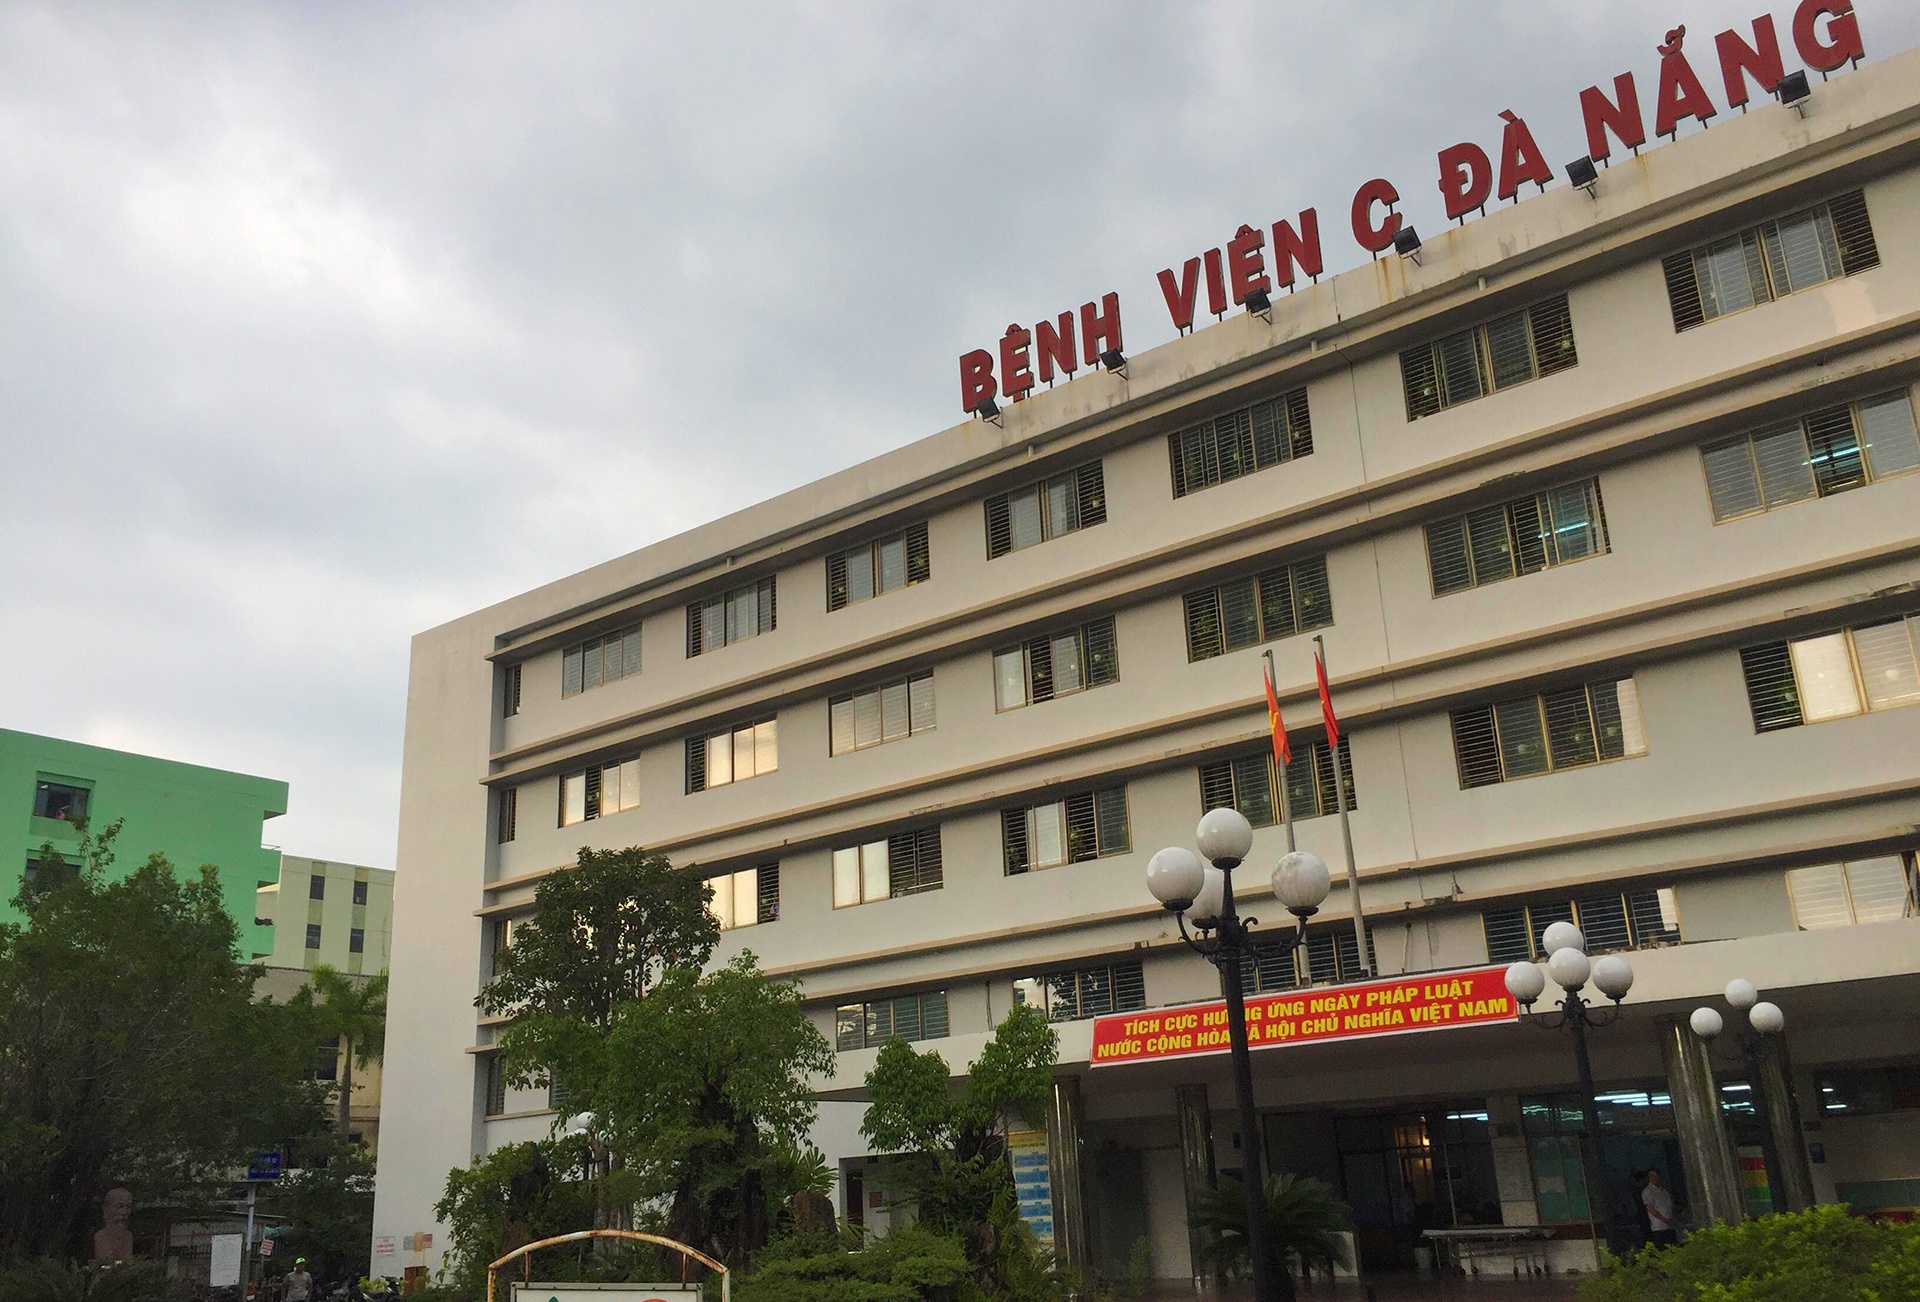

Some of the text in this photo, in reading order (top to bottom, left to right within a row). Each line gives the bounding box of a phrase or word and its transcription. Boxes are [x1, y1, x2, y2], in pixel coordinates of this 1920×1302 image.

[1351, 178, 1403, 252] C
[1437, 109, 1554, 221] ĐÀ
[1097, 1039, 1142, 1058] NƯỚC
[1146, 1034, 1192, 1053] CỘNG
[1196, 1027, 1231, 1047] HÒA
[1265, 1019, 1296, 1040] HỘI
[1301, 1012, 1339, 1035] CHỦ
[1344, 1008, 1405, 1031] NGHĨA
[1410, 1003, 1453, 1024] VIỆT
[1458, 997, 1508, 1018] NAM
[1124, 1018, 1160, 1036] TÍCH
[1164, 1013, 1198, 1031] CỰC
[1267, 1001, 1305, 1019] ỨNG
[1310, 993, 1361, 1015] NGÀY
[1366, 986, 1419, 1007] PHÁP
[1424, 980, 1474, 1000] LUẬT
